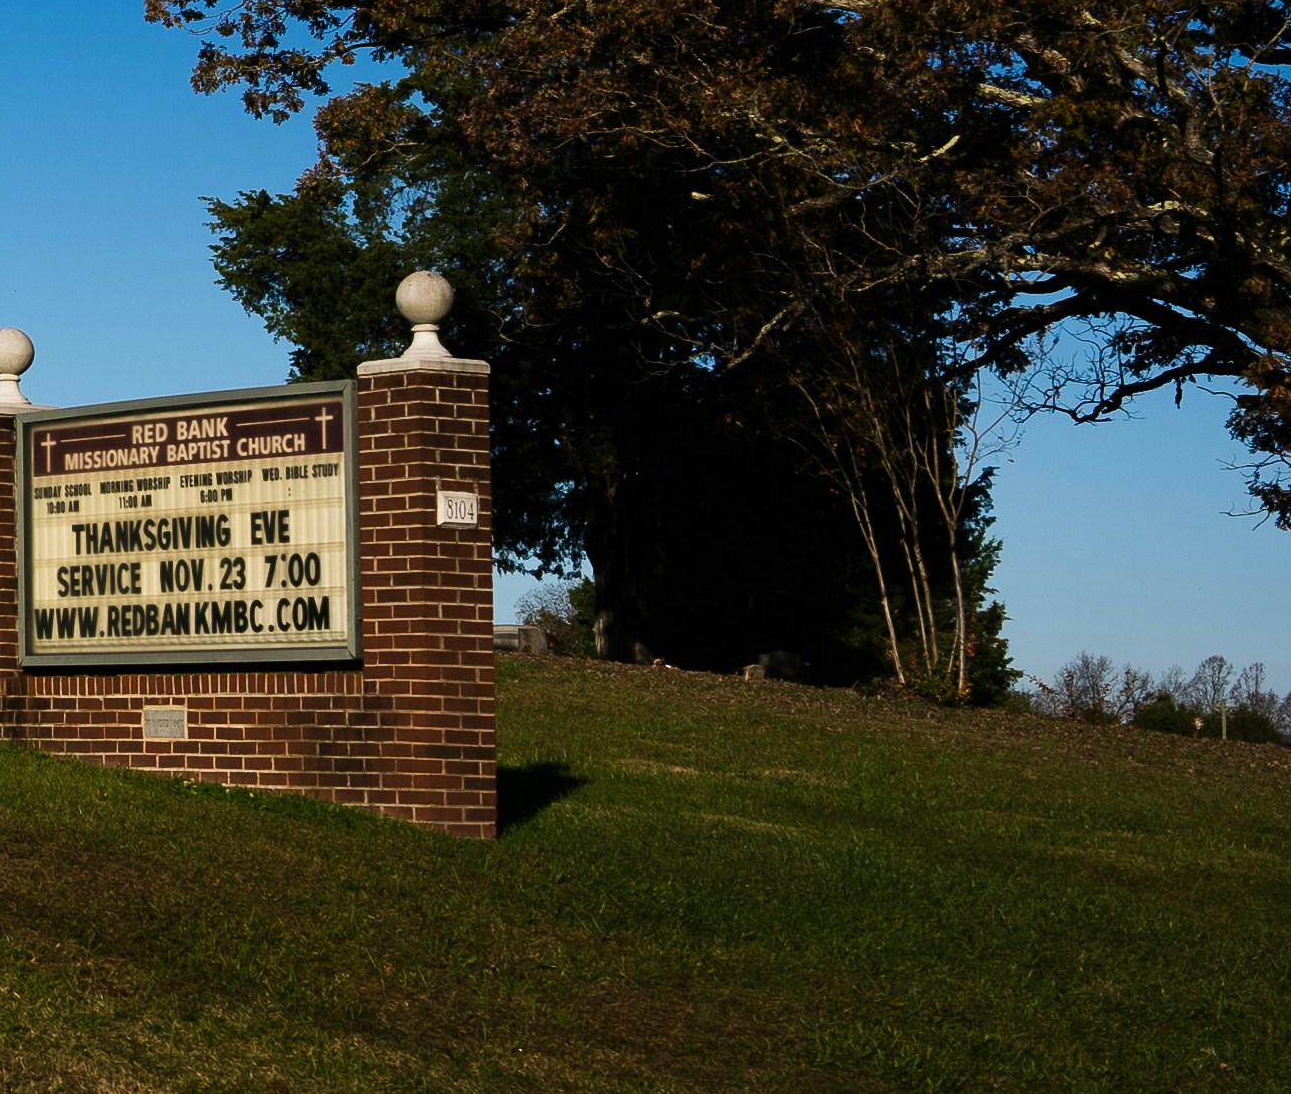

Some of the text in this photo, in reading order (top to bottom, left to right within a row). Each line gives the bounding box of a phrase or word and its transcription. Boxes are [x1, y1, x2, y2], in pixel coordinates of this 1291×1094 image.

[132, 417, 228, 444] RED BANK
[64, 433, 306, 471] MISSIONARY BAPTIST CHURCH
[180, 470, 252, 488] EVENING WORSHIP
[262, 463, 339, 481] WED. BIBLE STUDY
[34, 483, 92, 499] SUNDAY SCHOOL
[100, 476, 171, 494] MORNING WORSHIP
[119, 494, 152, 509] 11:00 AM
[200, 488, 233, 503] 6:00 PM
[46, 500, 80, 514] 10:00 AM
[447, 499, 474, 520] 8104
[72, 509, 290, 555] THANKSGIVING EVE
[57, 552, 321, 597] SERVICE NOV. 23 7:00
[34, 596, 330, 640] WWW.REDBANKMBC.COM
